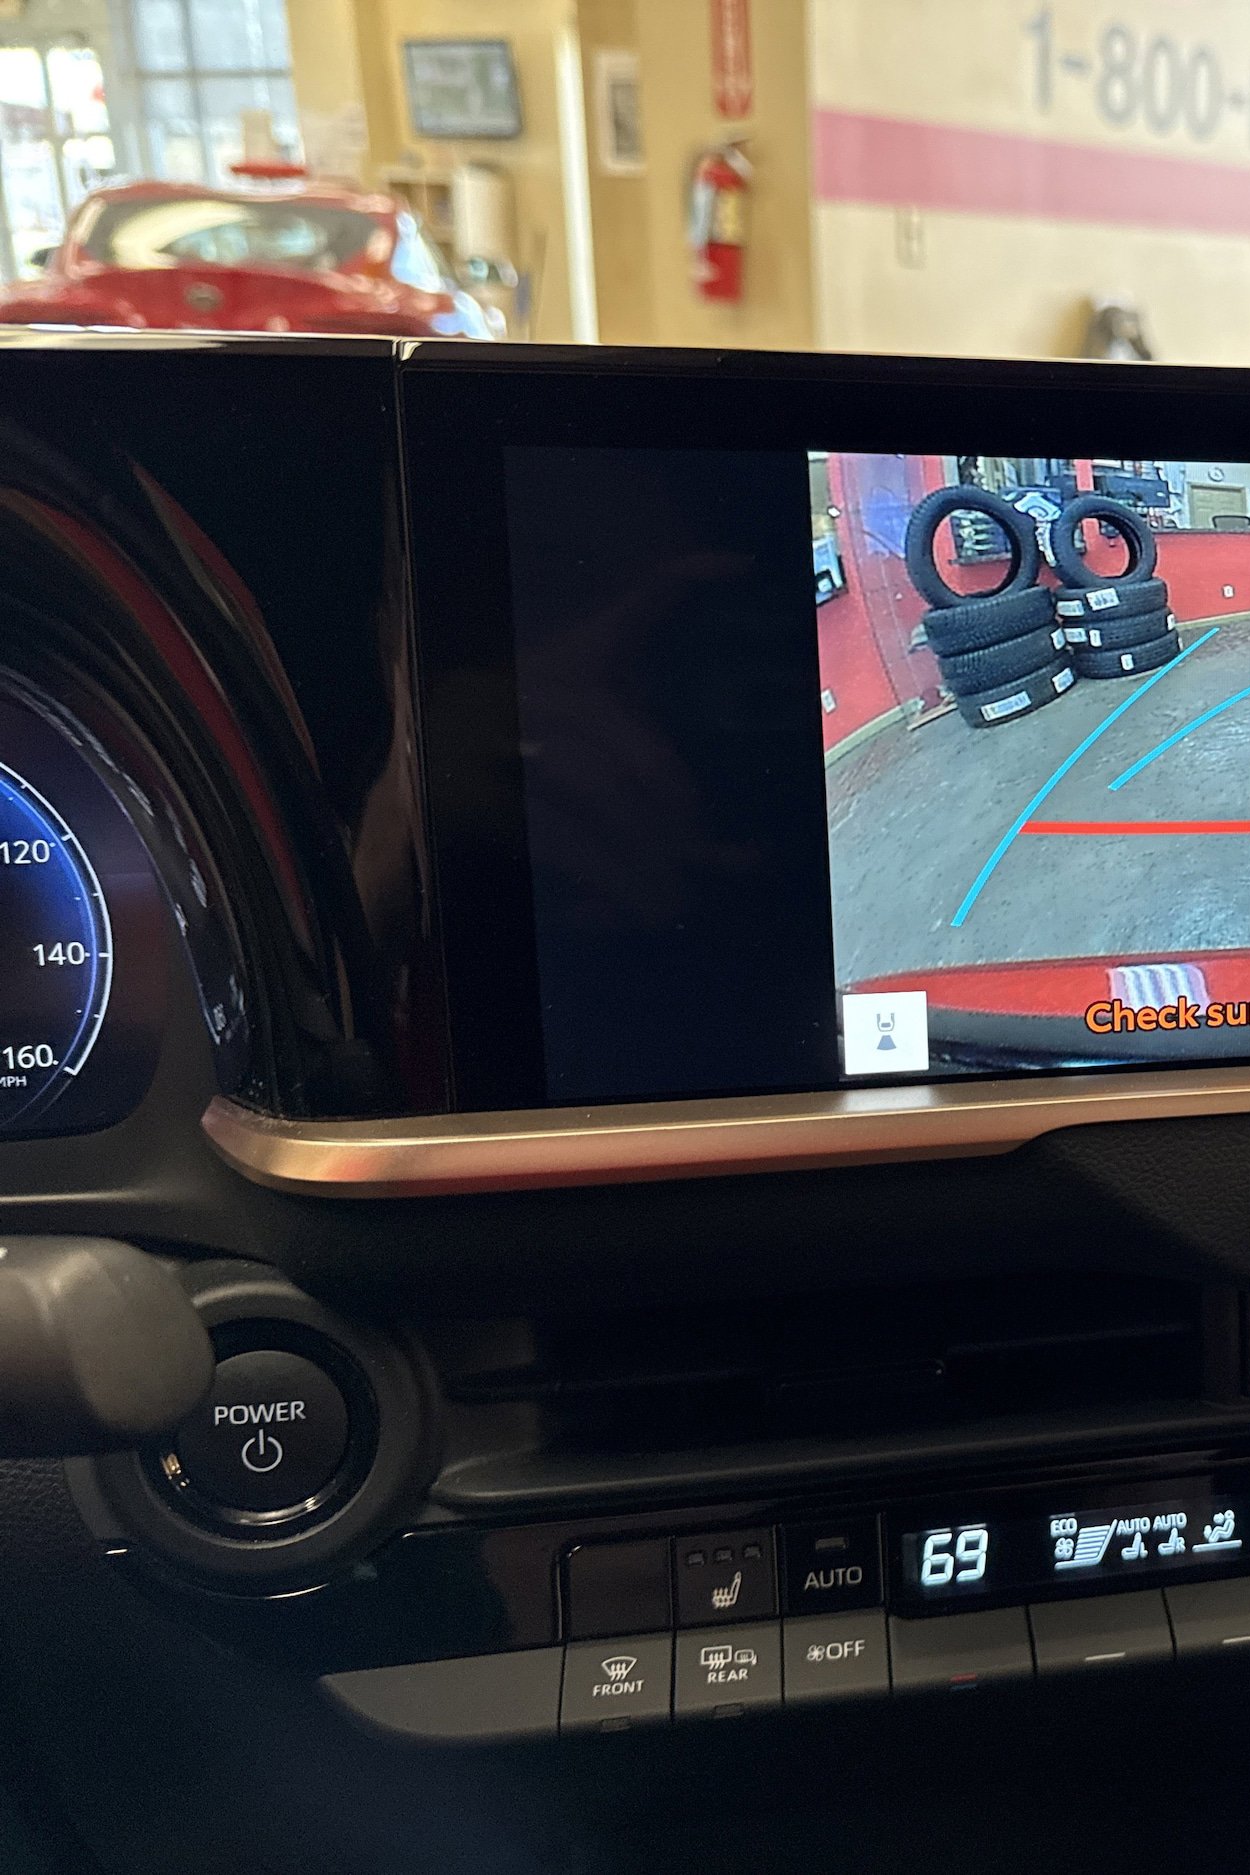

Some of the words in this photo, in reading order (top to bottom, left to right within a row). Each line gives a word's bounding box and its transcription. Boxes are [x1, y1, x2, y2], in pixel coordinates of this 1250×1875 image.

[0, 839, 50, 865] 120
[32, 941, 86, 967] 140
[1085, 996, 1201, 1034] Check
[2, 1044, 54, 1070] 160
[214, 1400, 306, 1427] POWER
[1050, 1517, 1078, 1538] ECO
[1116, 1516, 1151, 1537] AUTO
[1152, 1511, 1188, 1532] AUTO
[921, 1528, 989, 1587] 69
[804, 1566, 863, 1591] AUTO
[826, 1639, 866, 1660] OFF
[592, 1679, 645, 1697] FRONT
[707, 1668, 749, 1683] REAR
